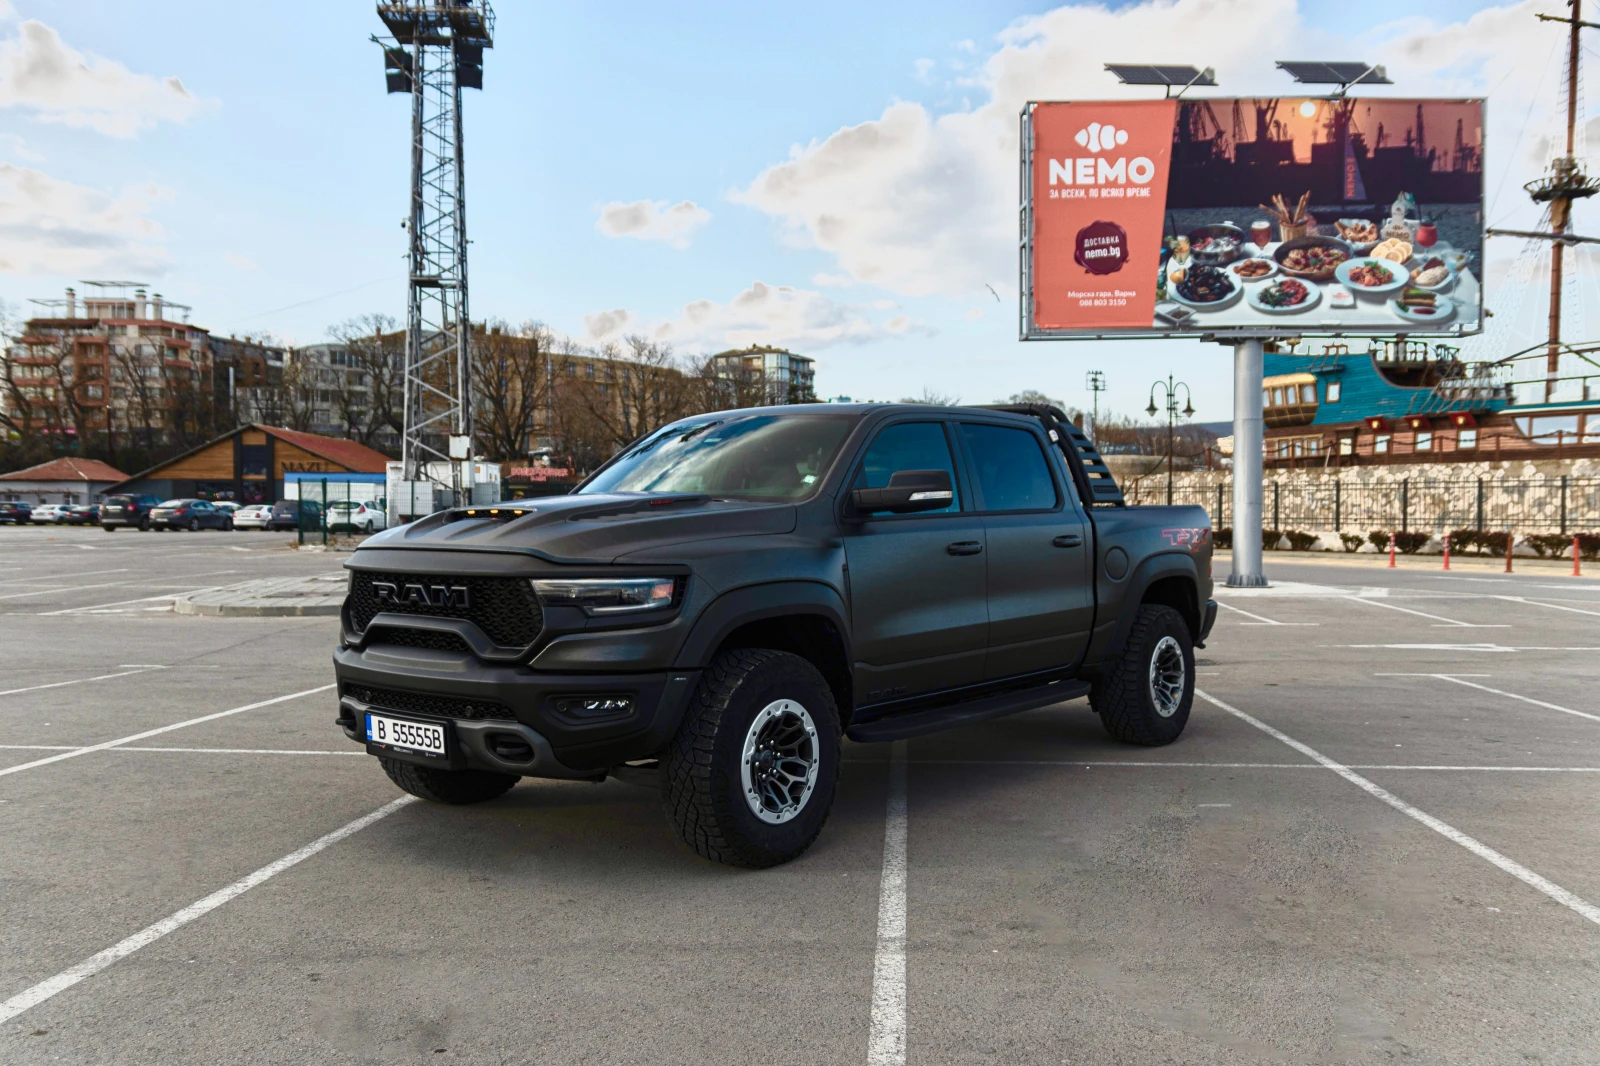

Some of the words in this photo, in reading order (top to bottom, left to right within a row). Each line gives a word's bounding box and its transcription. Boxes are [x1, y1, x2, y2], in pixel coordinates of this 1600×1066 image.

[1049, 156, 1155, 185] NEMO
[1049, 188, 1059, 198] ЗА
[1089, 187, 1099, 197] ПО
[1101, 187, 1125, 197] ВСЯКО
[1126, 187, 1151, 197] ВРЕМЕ
[1084, 235, 1120, 247] ДОСТАВКА
[1085, 246, 1121, 258] nemo.bg
[1115, 290, 1136, 298] Варна
[371, 581, 470, 608] RAM
[377, 720, 387, 740] B
[392, 722, 442, 750] 55555B
